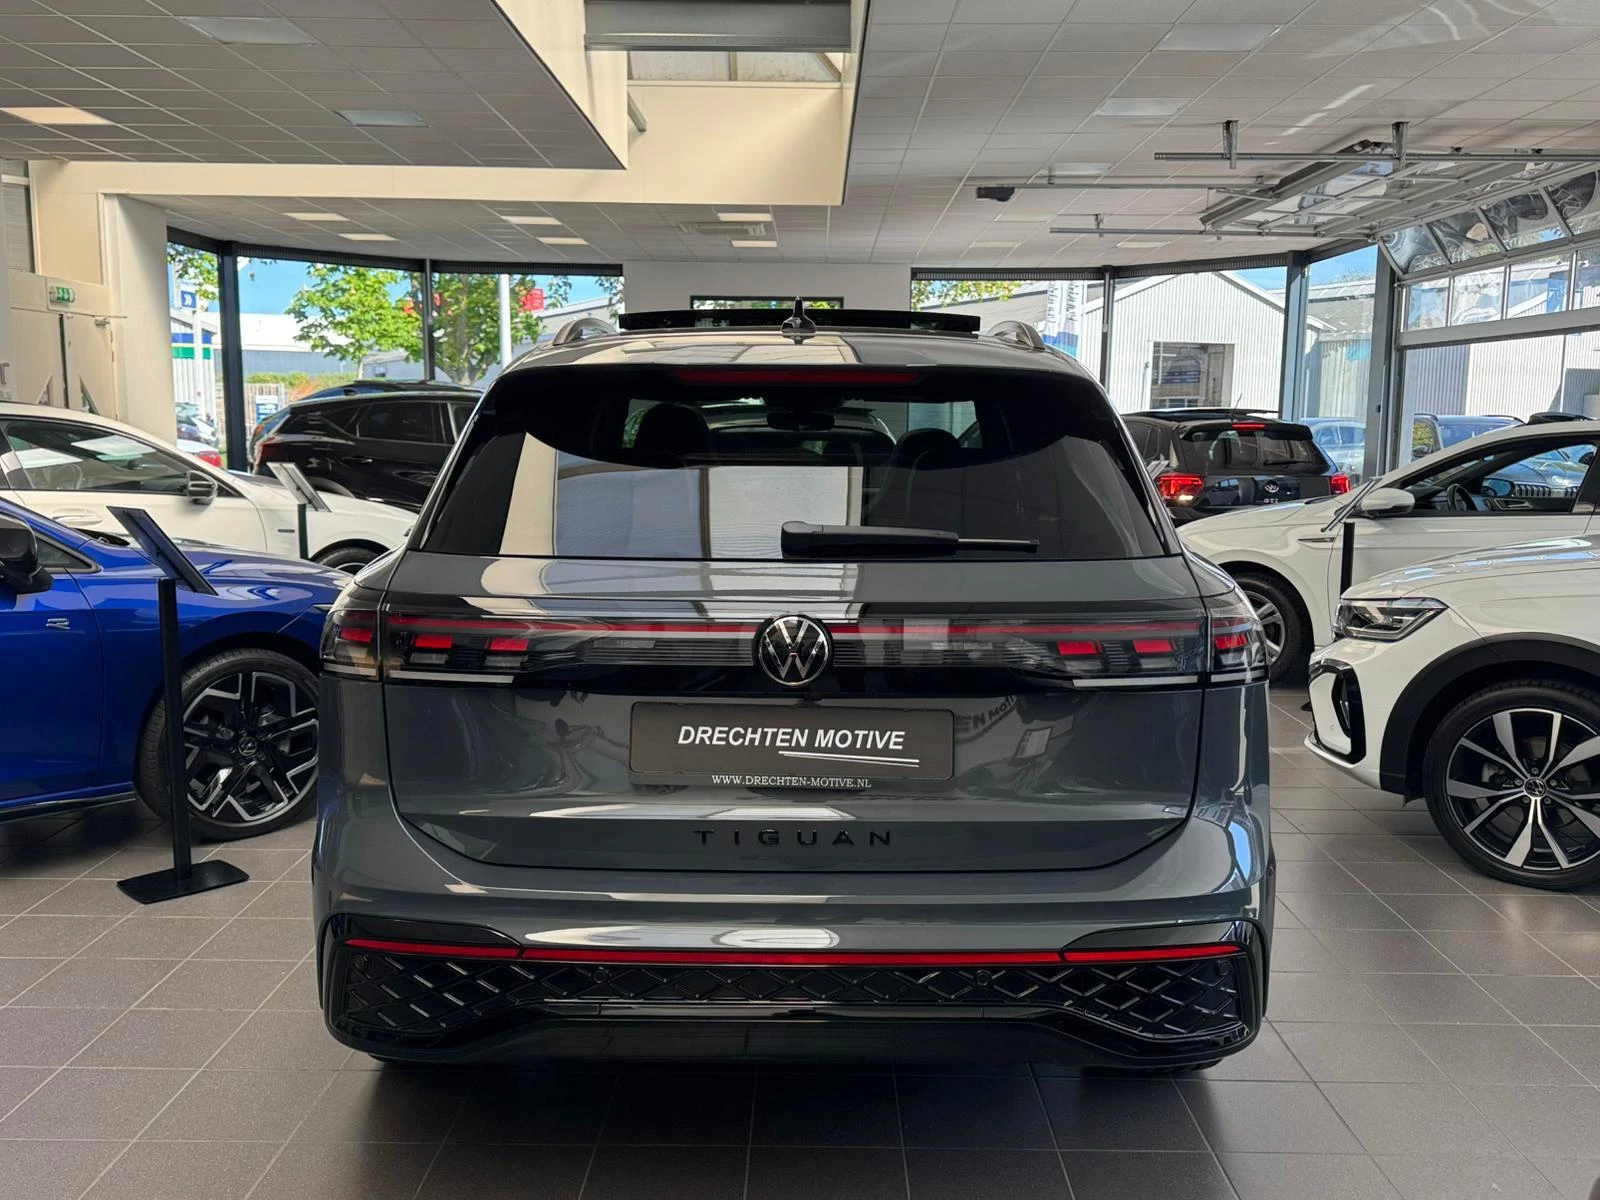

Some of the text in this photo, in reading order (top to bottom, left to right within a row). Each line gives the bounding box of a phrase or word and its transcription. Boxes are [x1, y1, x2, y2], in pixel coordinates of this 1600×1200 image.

[677, 725, 906, 750] DRECHTEN MOTIVE
[712, 774, 872, 789] WWW.DRECHTEN-MOTIVE.NL
[693, 829, 891, 846] TIGUAN
